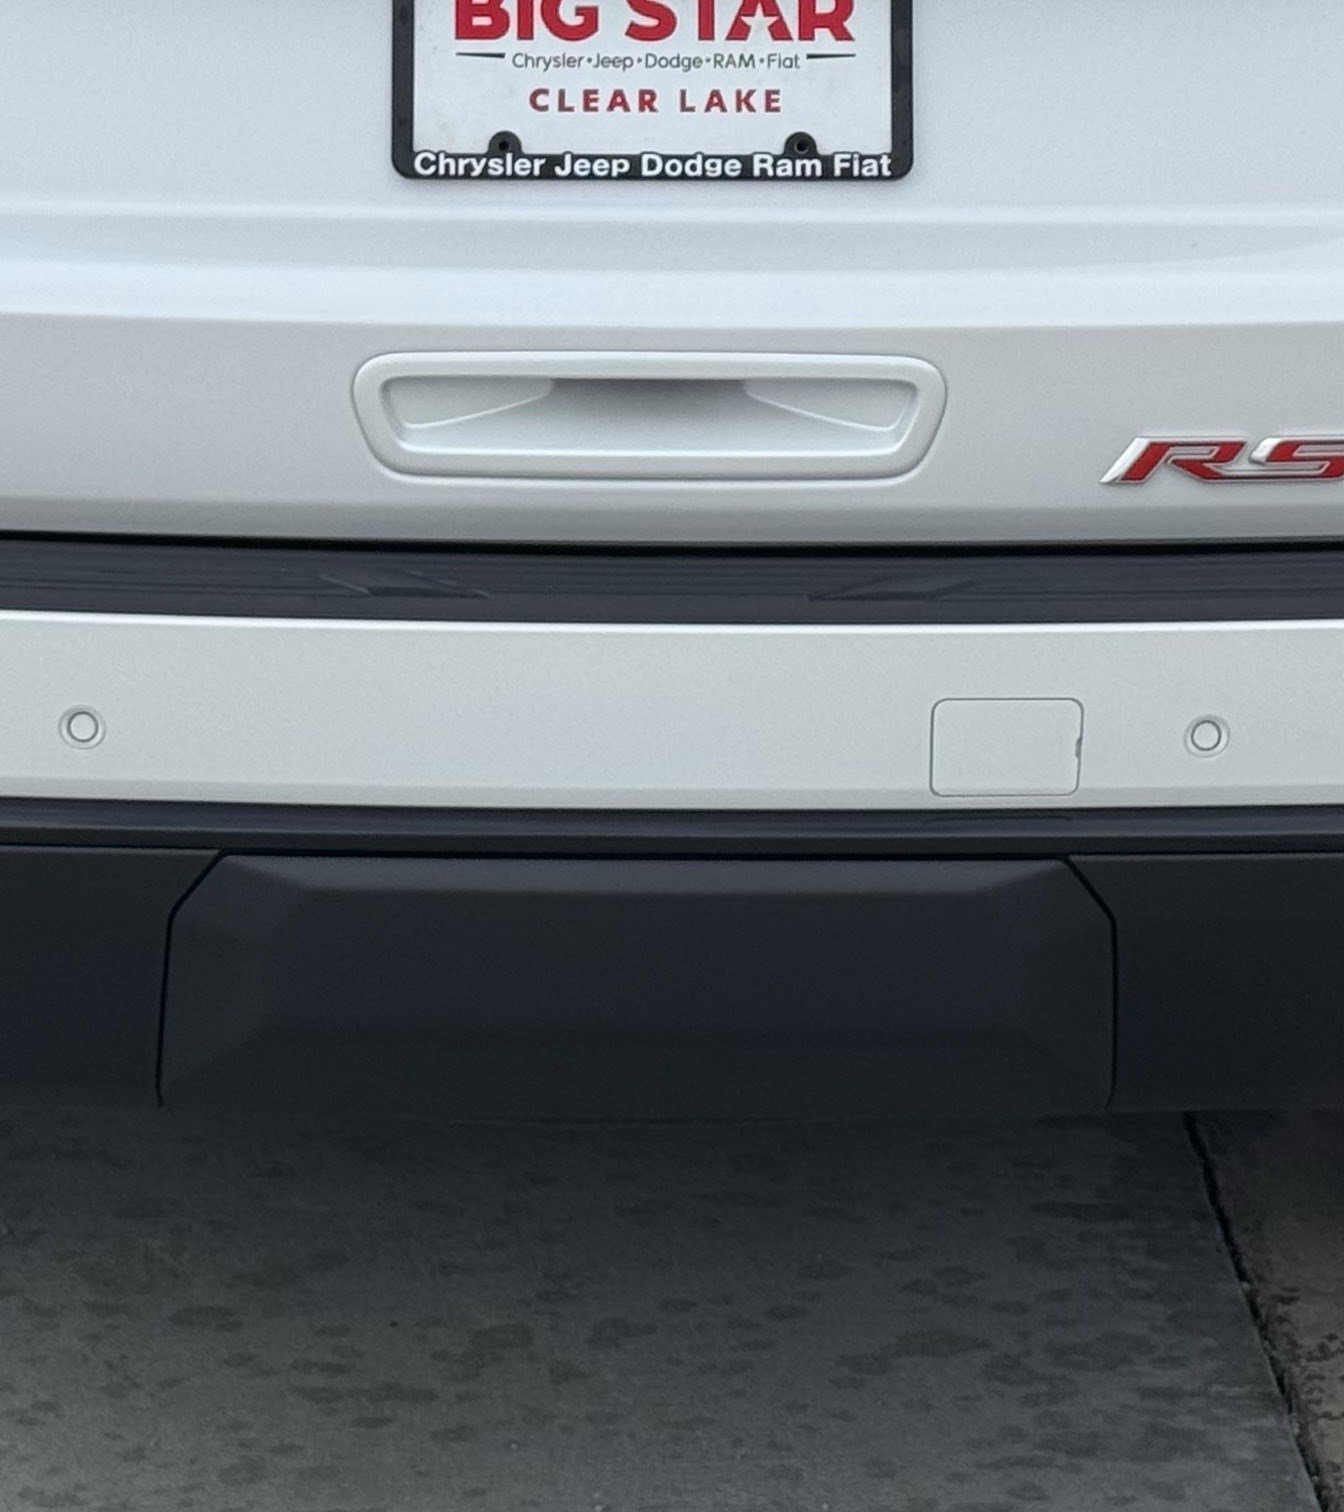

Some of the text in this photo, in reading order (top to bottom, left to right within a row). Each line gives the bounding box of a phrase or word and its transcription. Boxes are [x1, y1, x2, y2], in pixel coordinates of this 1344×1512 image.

[512, 52, 801, 73] Chrysler Jeep Dodge RAM Fiat
[529, 88, 782, 113] CLEAR LAKE
[413, 151, 893, 178] Chrysler Jeep Dodge Ram Fiat
